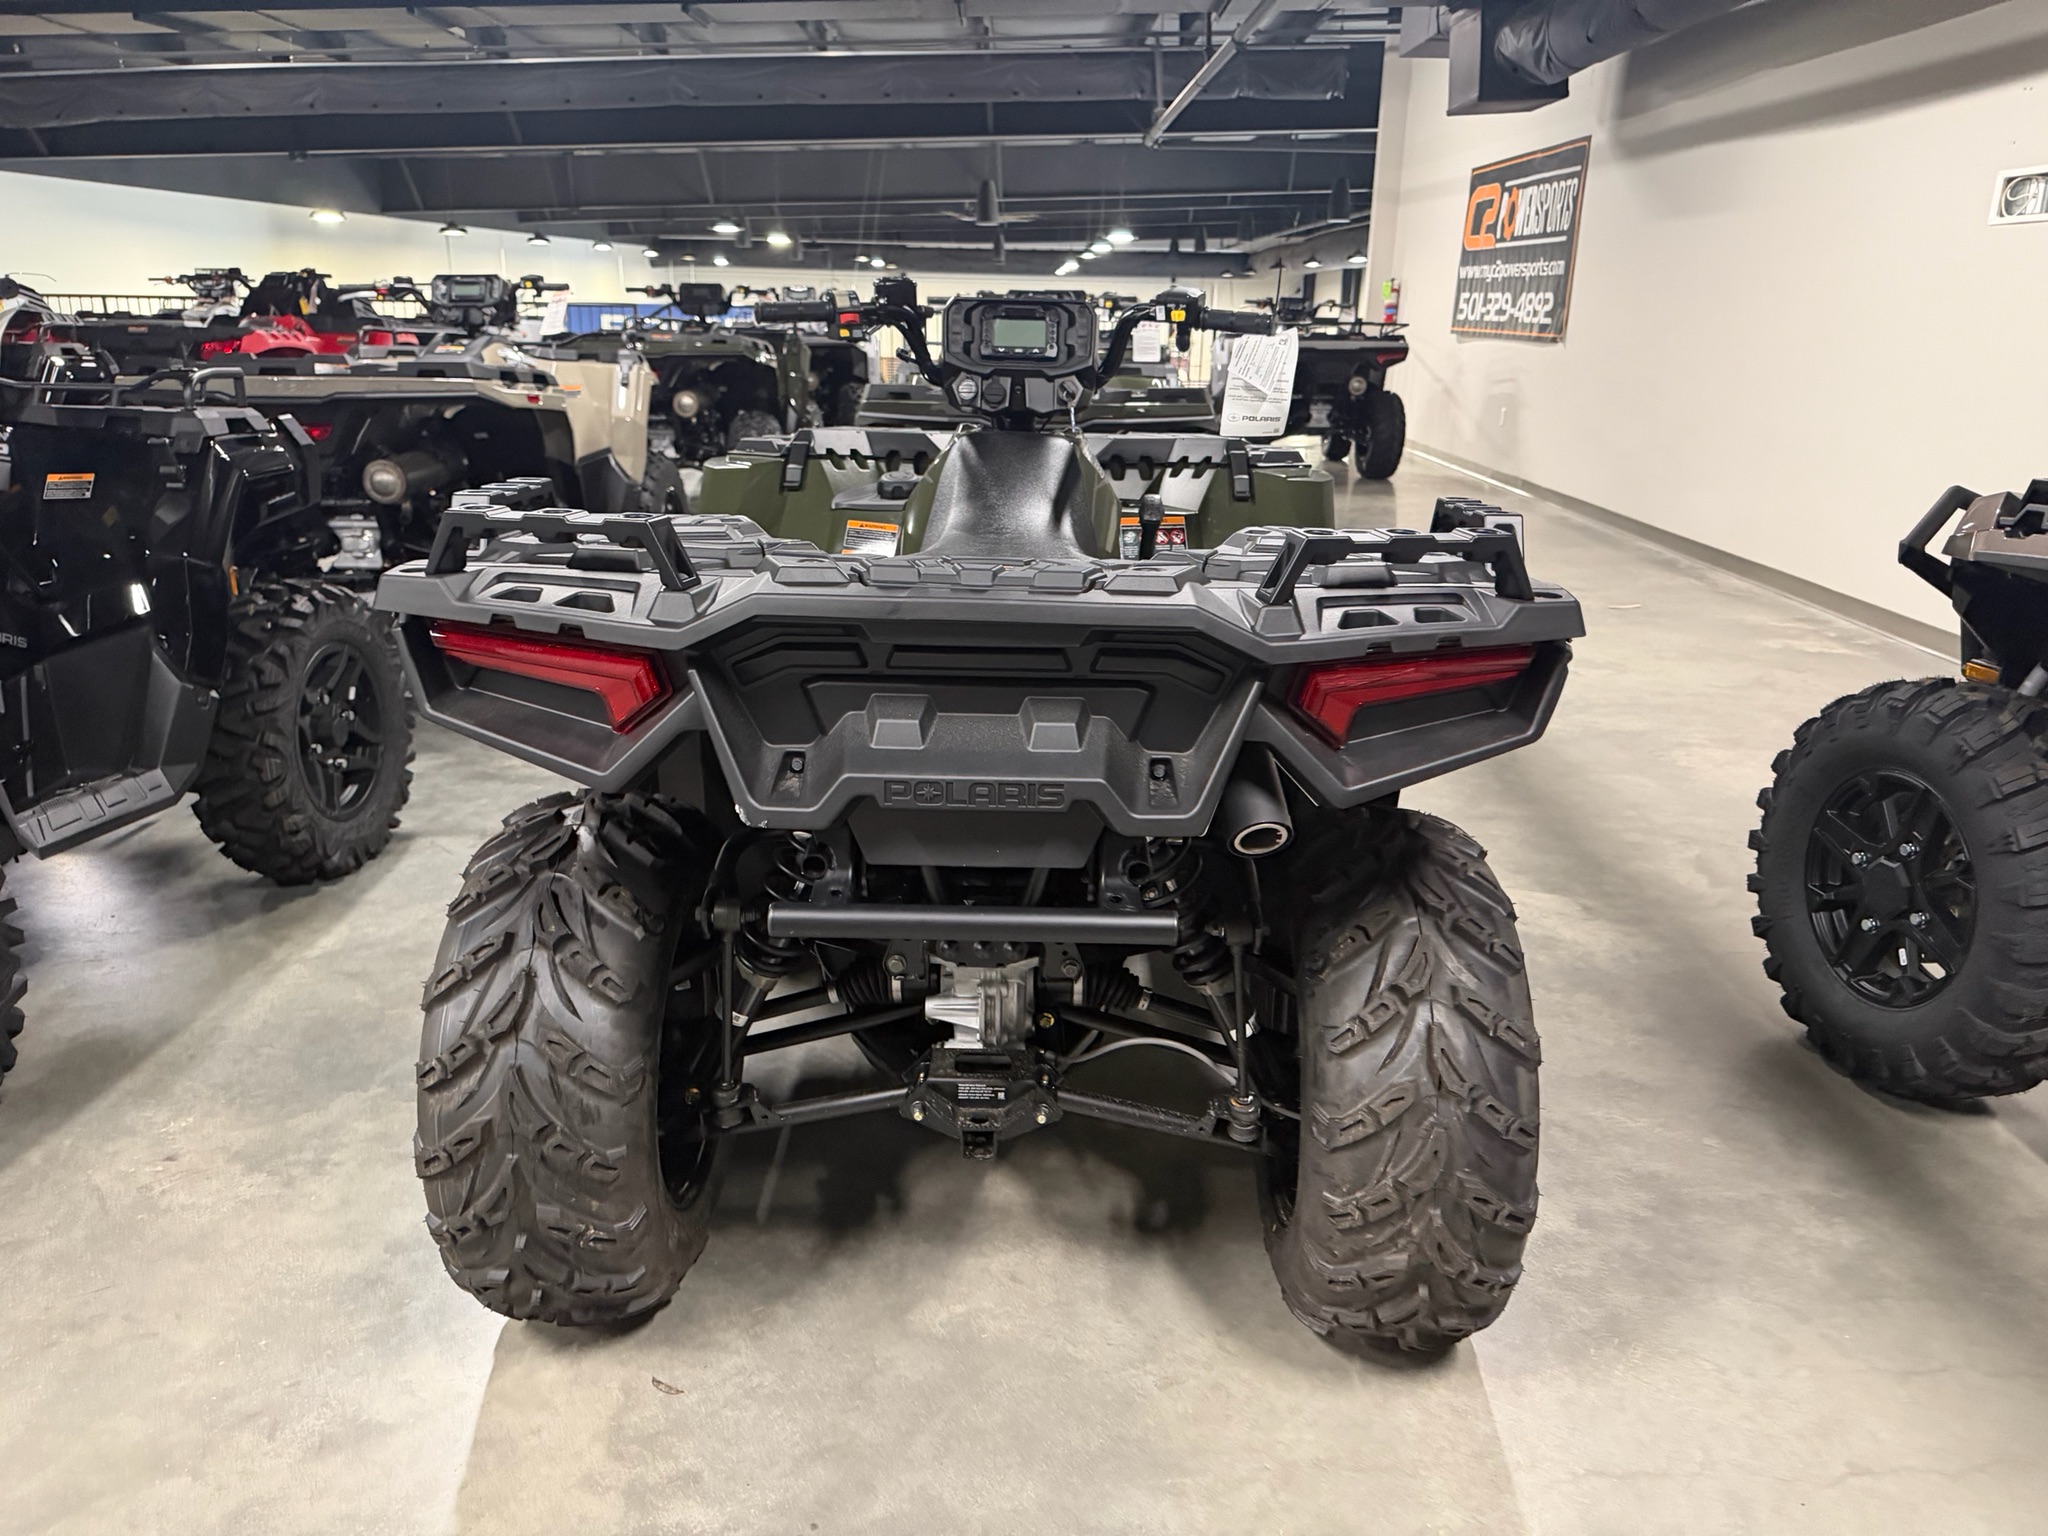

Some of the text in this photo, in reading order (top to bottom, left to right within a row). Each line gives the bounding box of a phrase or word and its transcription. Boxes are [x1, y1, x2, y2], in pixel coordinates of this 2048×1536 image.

[1456, 291, 1555, 324] 501-329-4892
[1241, 415, 1282, 423] POLARIS
[883, 780, 1066, 809] POLARIS
